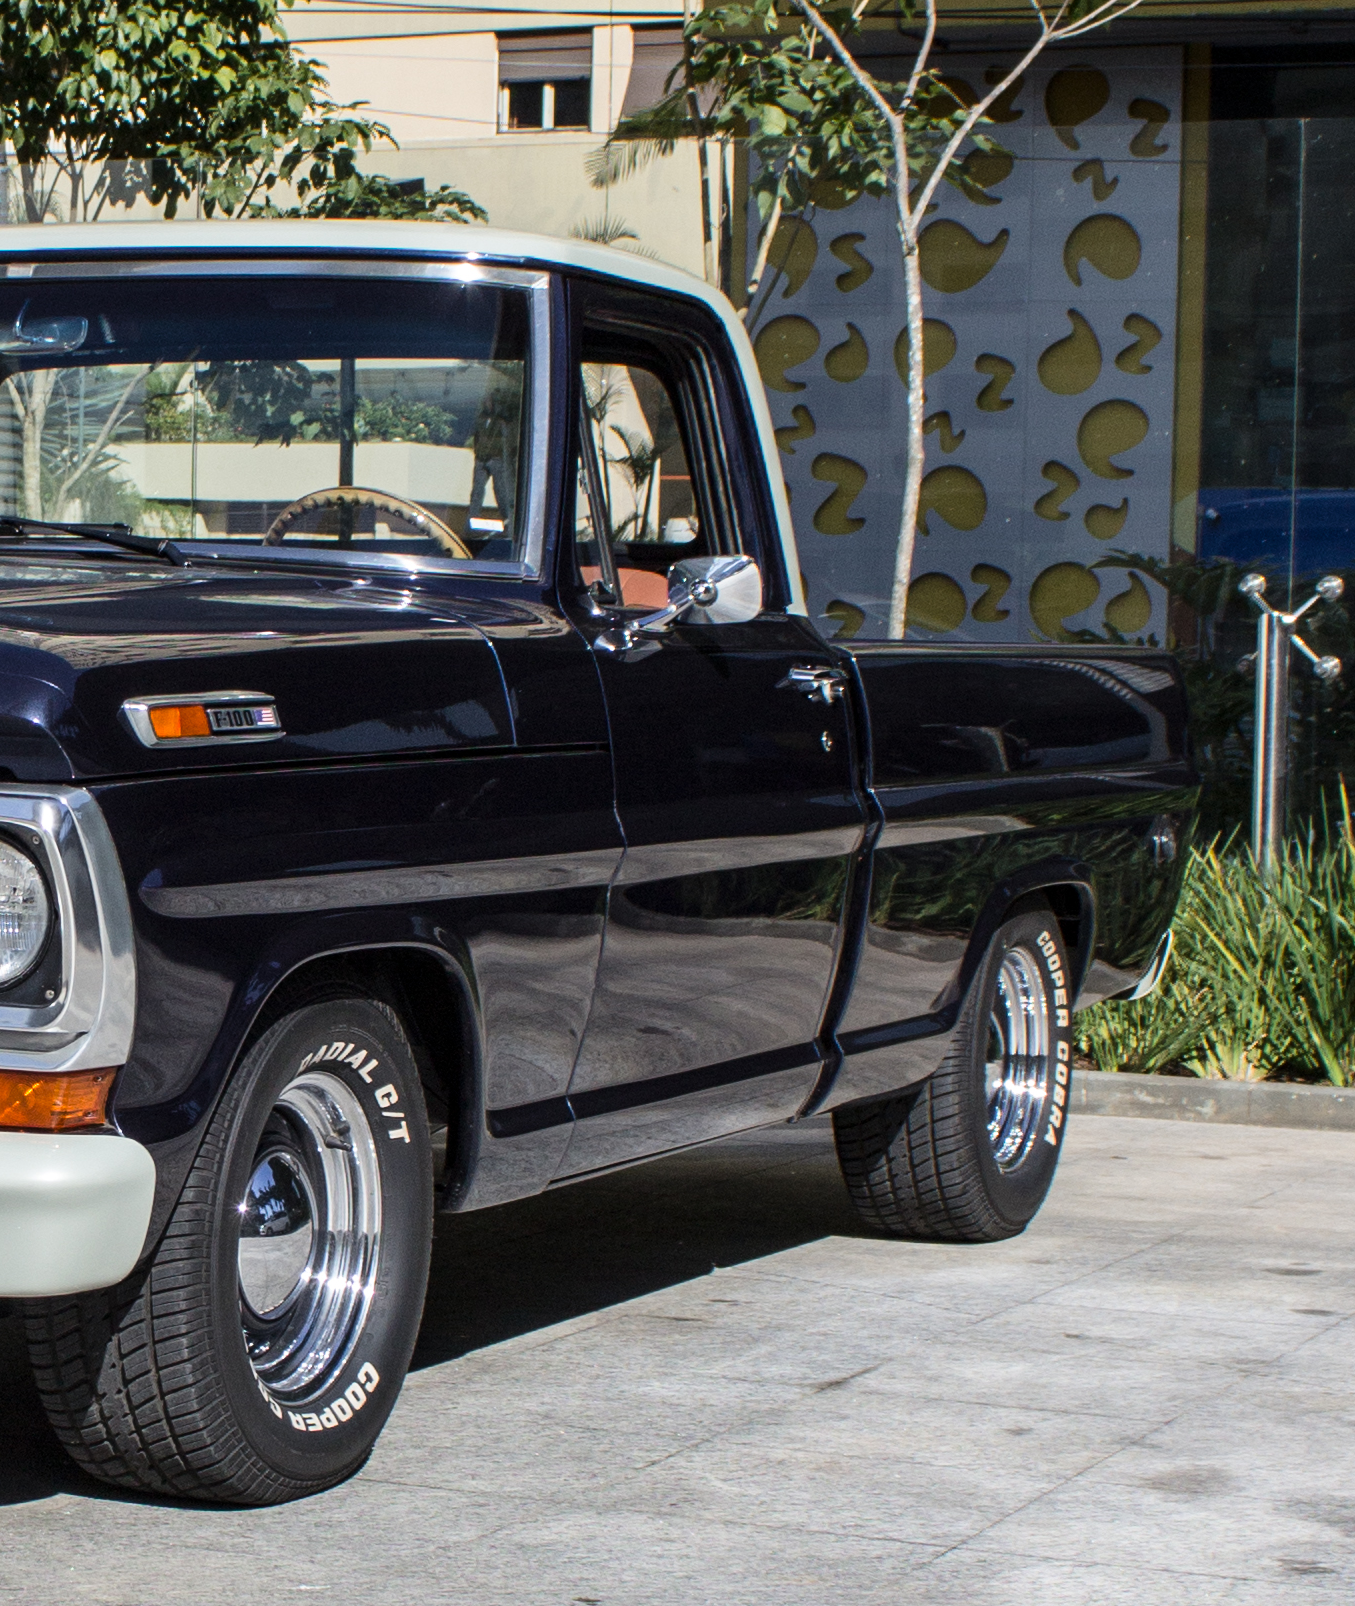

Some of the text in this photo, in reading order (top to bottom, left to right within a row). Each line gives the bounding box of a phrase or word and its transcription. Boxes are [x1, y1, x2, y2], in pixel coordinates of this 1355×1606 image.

[213, 709, 254, 728] F-100
[1036, 930, 1070, 1146] COOPER COBRA
[374, 1083, 411, 1144] G/T
[287, 1361, 381, 1432] COOPER
